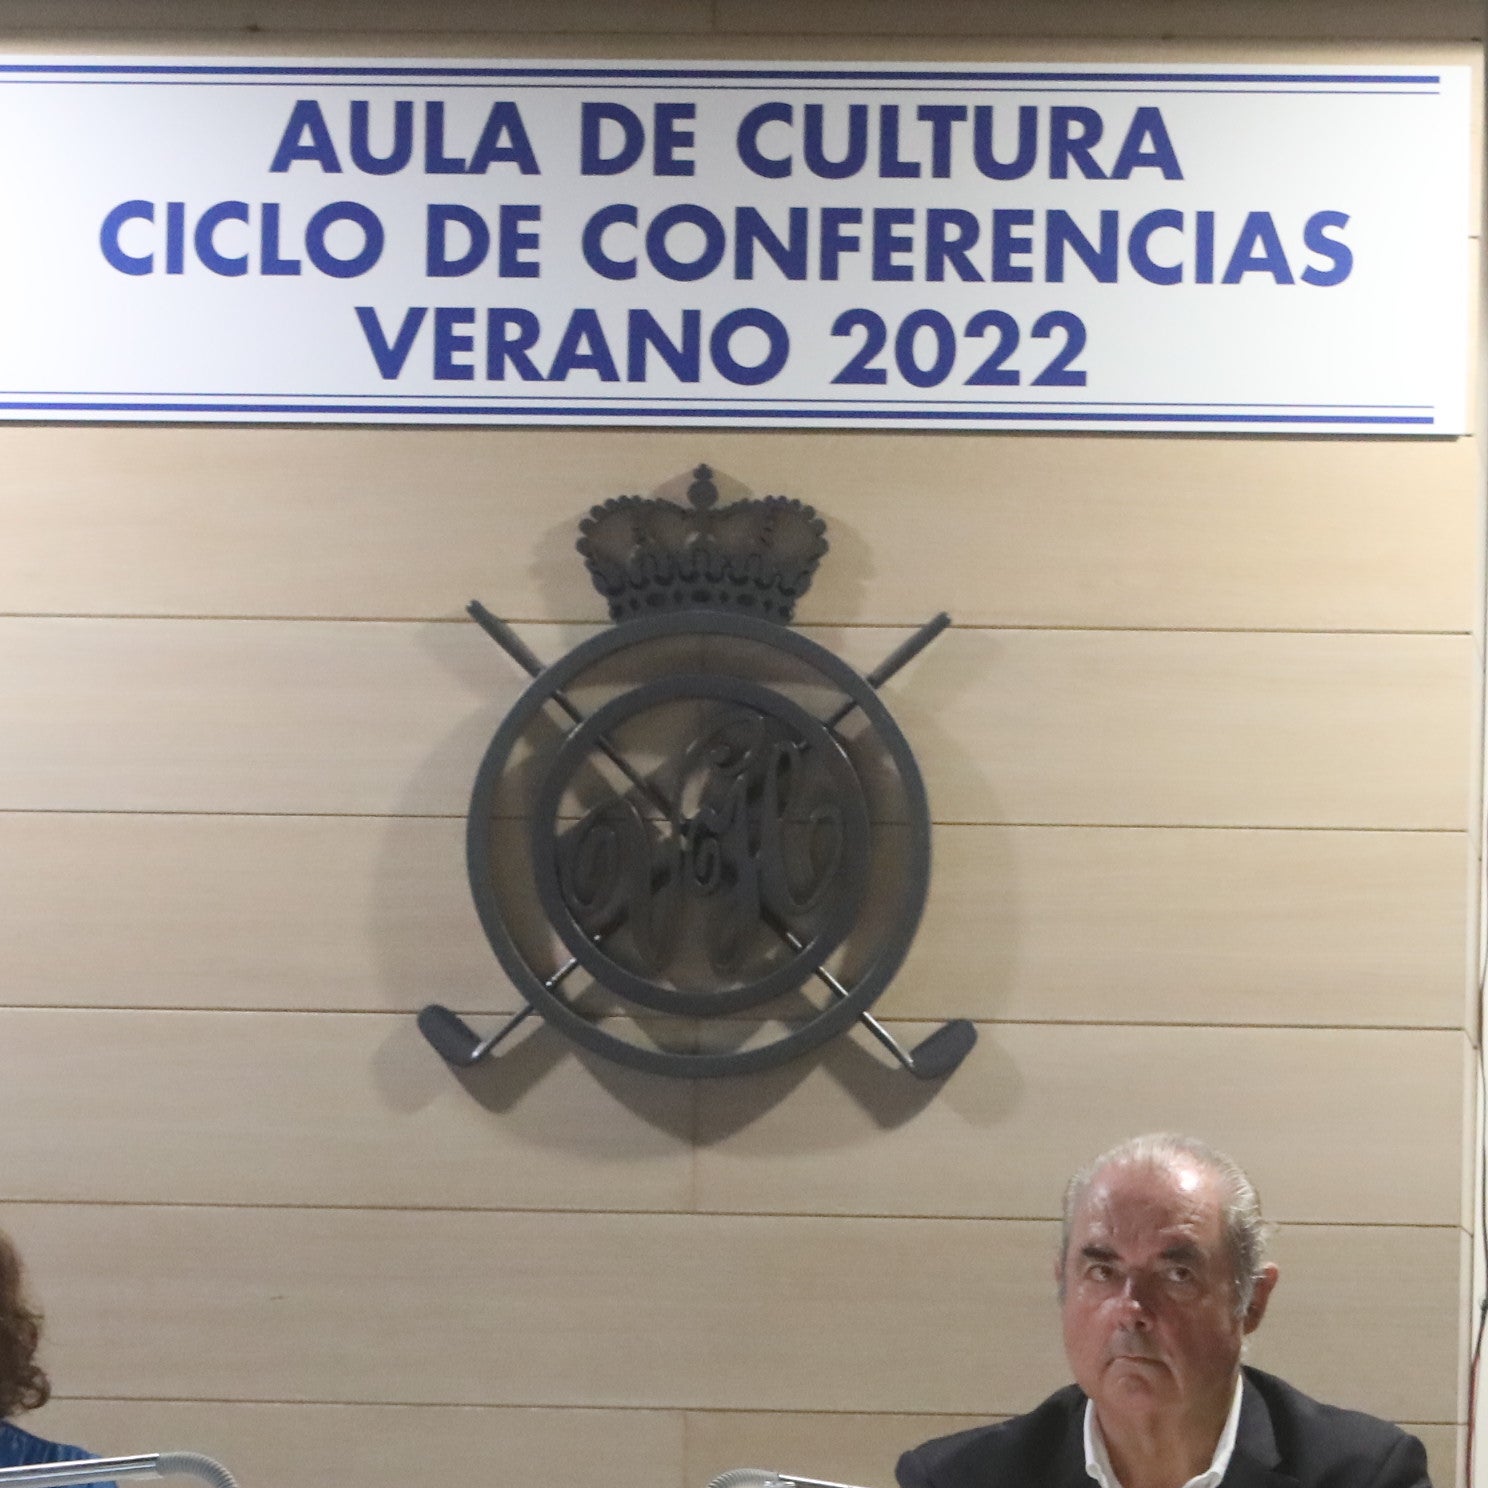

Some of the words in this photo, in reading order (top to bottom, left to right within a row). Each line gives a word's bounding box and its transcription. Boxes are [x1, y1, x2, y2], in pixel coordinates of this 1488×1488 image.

[270, 100, 541, 175] AULA
[581, 102, 696, 176] DE
[753, 102, 1182, 181] CULTURA
[100, 200, 385, 279] CICLO
[427, 204, 541, 278] DE
[581, 203, 1352, 286] CONFERENCIAS
[355, 307, 790, 386] VERANO
[830, 308, 1086, 388] 2022
